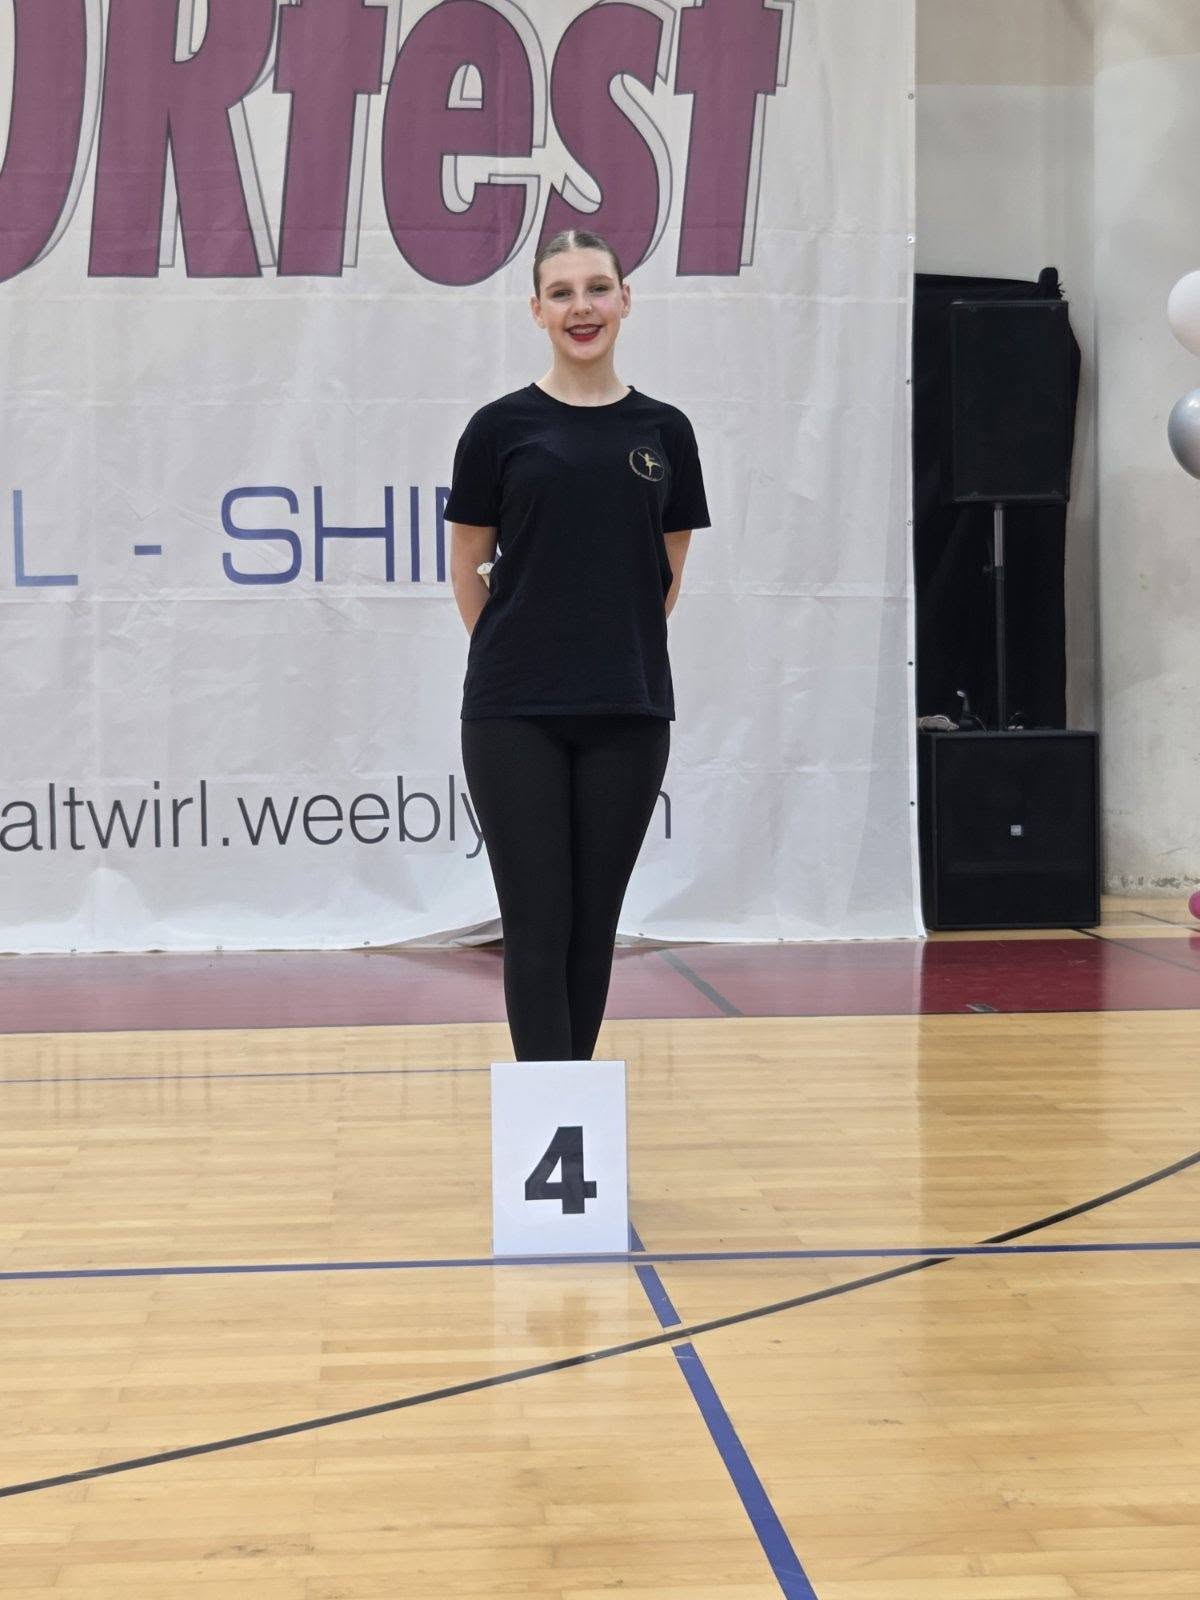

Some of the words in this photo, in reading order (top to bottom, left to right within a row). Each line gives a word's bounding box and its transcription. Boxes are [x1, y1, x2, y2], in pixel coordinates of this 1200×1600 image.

[13, 490, 78, 587] L
[0, 774, 672, 859] altwirl.weebly
[524, 1125, 597, 1215] 4
